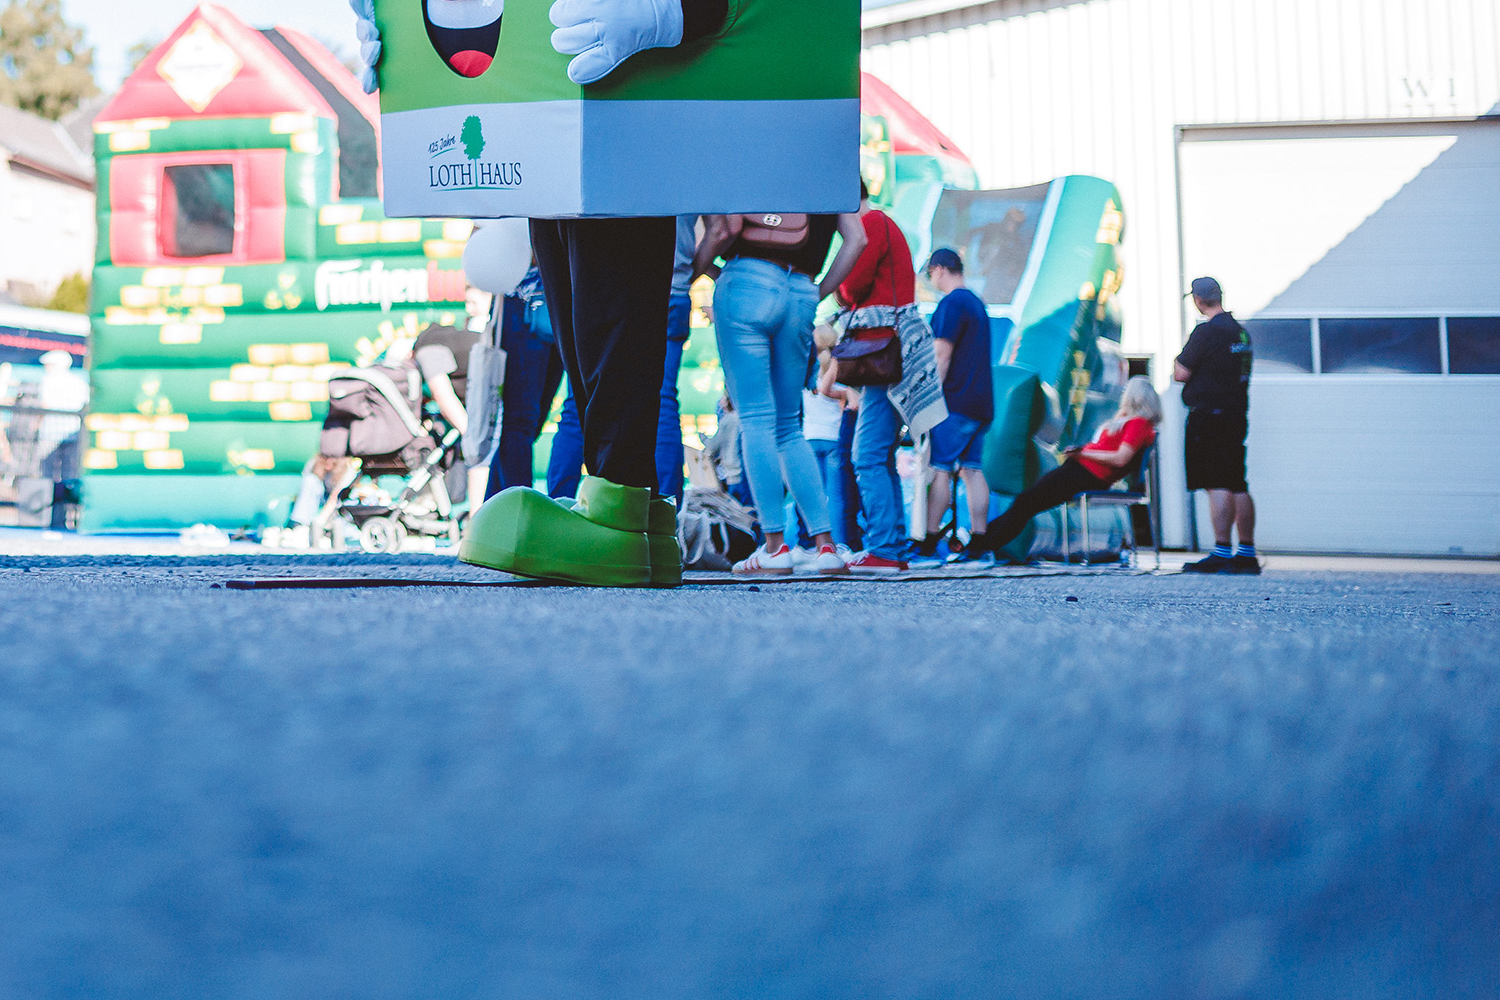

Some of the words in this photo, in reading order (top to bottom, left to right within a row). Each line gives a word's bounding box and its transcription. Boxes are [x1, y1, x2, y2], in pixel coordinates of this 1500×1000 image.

[428, 140, 438, 154] 125
[439, 134, 456, 150] Jahre
[429, 163, 472, 187] LOTH
[480, 162, 522, 186] HAUS
